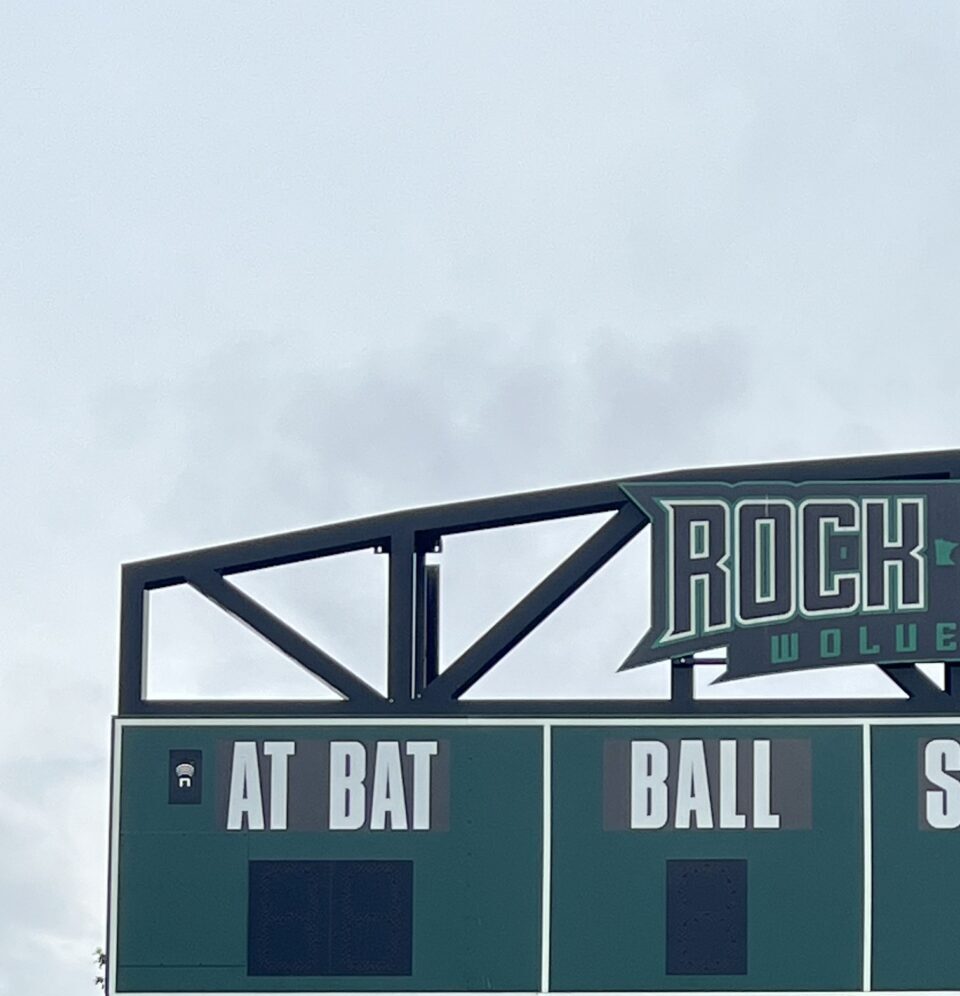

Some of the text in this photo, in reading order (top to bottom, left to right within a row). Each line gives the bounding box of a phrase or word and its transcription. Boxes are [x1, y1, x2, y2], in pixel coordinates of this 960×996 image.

[656, 496, 927, 647] ROCK
[226, 741, 438, 830] AT BAT
[630, 739, 780, 829] BALL
